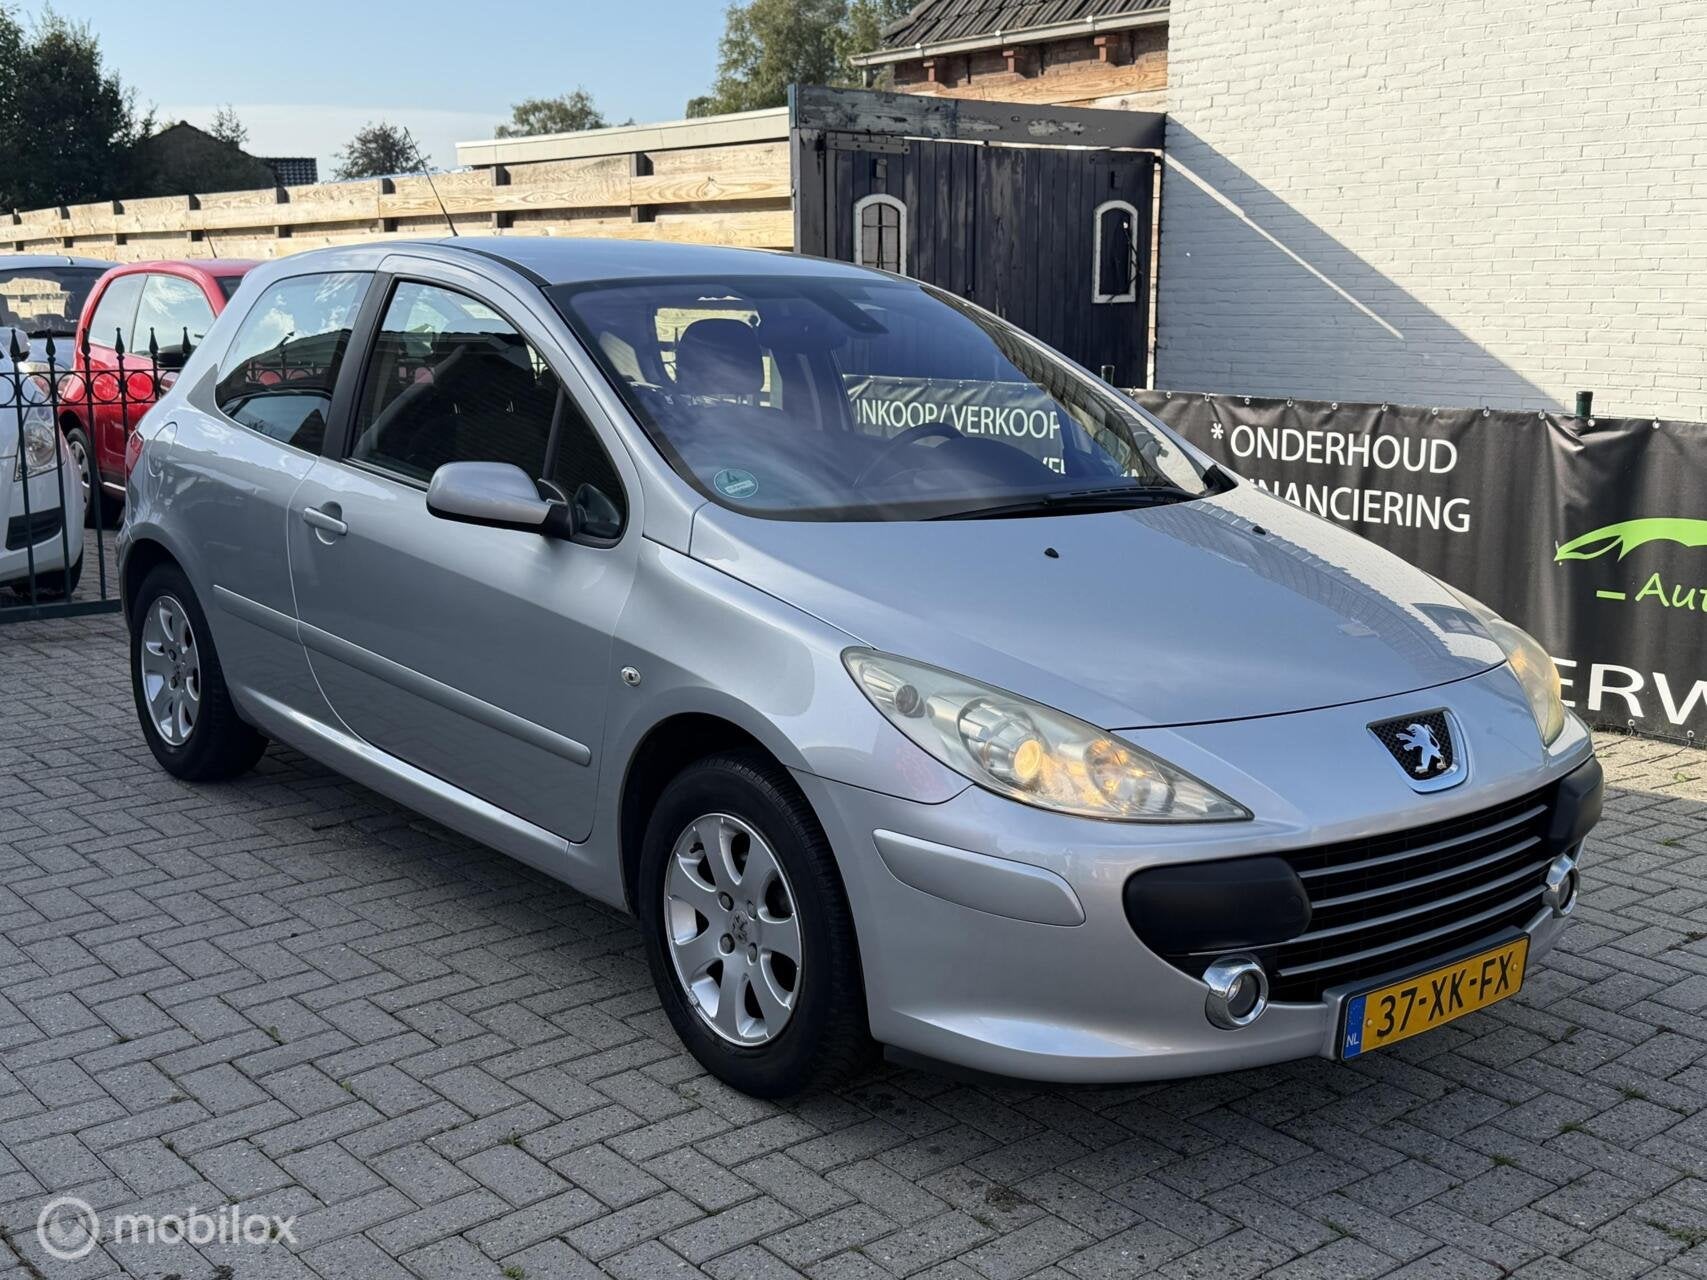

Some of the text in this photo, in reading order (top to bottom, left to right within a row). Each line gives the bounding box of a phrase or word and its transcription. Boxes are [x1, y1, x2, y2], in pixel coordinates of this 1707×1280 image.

[1230, 425, 1457, 474] ONDERHOUD
[1249, 478, 1471, 533] ANCIERING
[1376, 952, 1514, 1038] 37-XK-FX
[1346, 1032, 1360, 1048] NL
